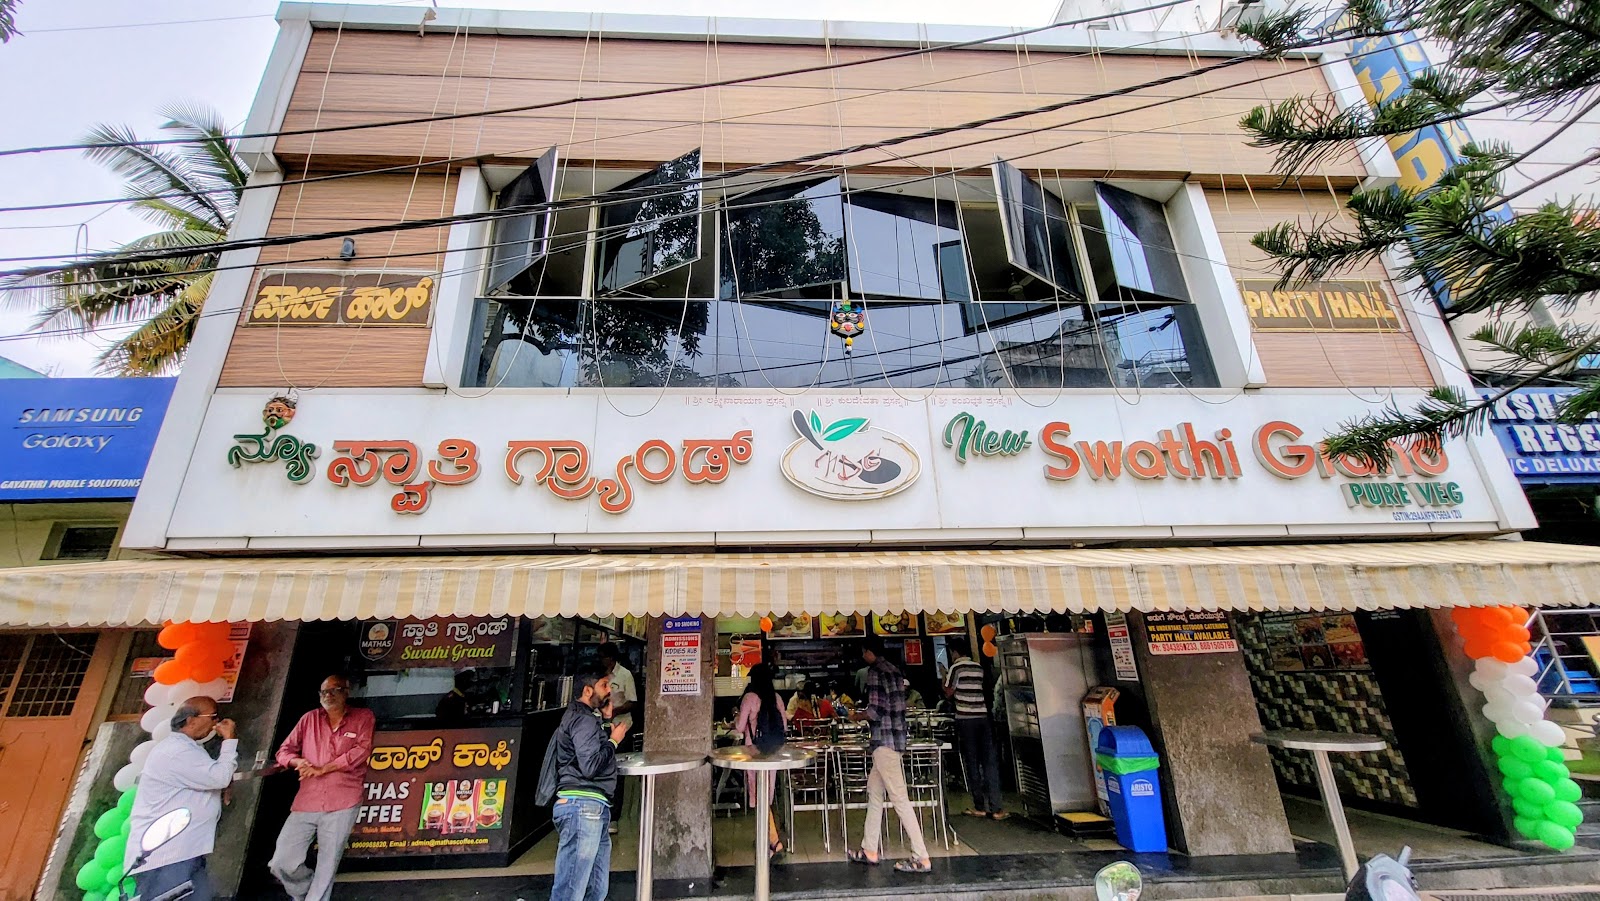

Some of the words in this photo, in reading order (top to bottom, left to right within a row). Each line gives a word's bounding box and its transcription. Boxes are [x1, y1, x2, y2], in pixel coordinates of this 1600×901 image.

[1242, 290, 1323, 318] PARTY
[1328, 290, 1393, 319] HALL
[19, 407, 144, 424] SAMSUNG
[22, 433, 113, 453] Galaxy
[943, 411, 1032, 464] New
[1513, 424, 1600, 452] REGE
[1040, 421, 1243, 481] Swathi
[228, 427, 321, 485] ನ್ಯೂ
[327, 439, 481, 515] ಸ್ವಾತಿ
[1532, 459, 1600, 472] DELUXE
[1, 479, 46, 489] GAYATHRI
[49, 479, 86, 489] MOBILE
[87, 478, 141, 488] SOLUTIONS
[1347, 482, 1410, 506] PURE
[1413, 481, 1464, 506] VEG
[361, 640, 392, 648] MATHAS
[402, 622, 438, 646] ಸ್ವಾತಿ
[1151, 633, 1172, 642] PARTY
[1174, 632, 1192, 641] HALL
[1193, 631, 1230, 640] AVAILABLE
[401, 646, 450, 660] Swathi
[451, 644, 496, 662] Grand
[367, 738, 443, 770] ತಾಸ್
[453, 741, 511, 770] ಕಾಫಿ
[364, 781, 410, 800] HAS
[1131, 783, 1153, 791] ARISTO
[355, 804, 404, 824] FFEE
